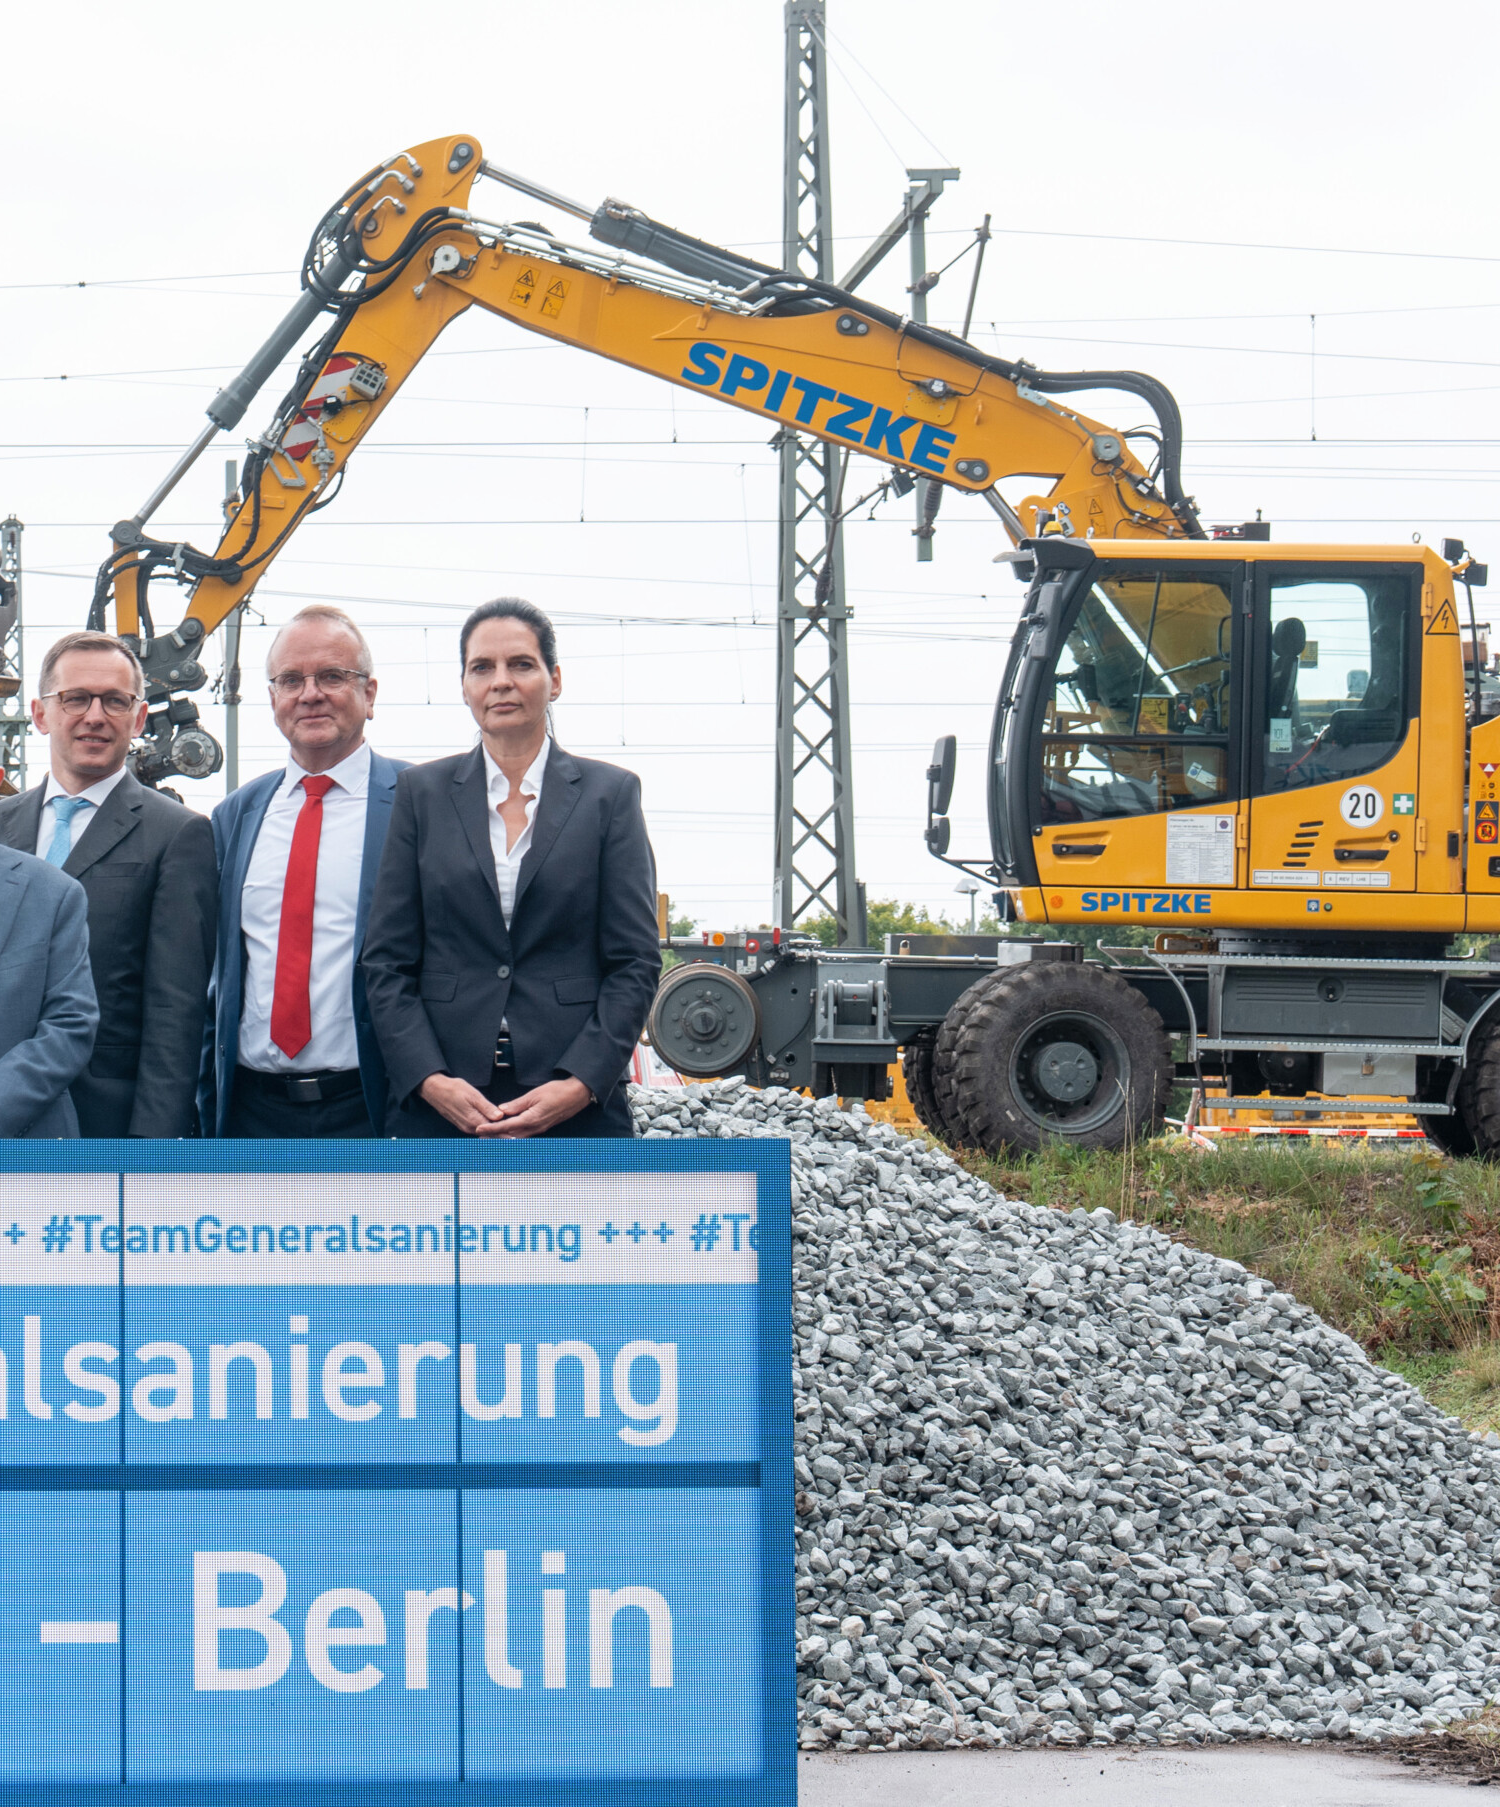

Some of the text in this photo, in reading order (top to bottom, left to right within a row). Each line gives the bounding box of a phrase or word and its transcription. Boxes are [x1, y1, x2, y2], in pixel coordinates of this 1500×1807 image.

[680, 341, 958, 475] SPITZKE
[1349, 792, 1376, 819] 20
[1081, 892, 1212, 914] SPITZKE
[41, 1213, 582, 1263] #TeamGeneralsanierung
[192, 1549, 674, 1692] Berlin
